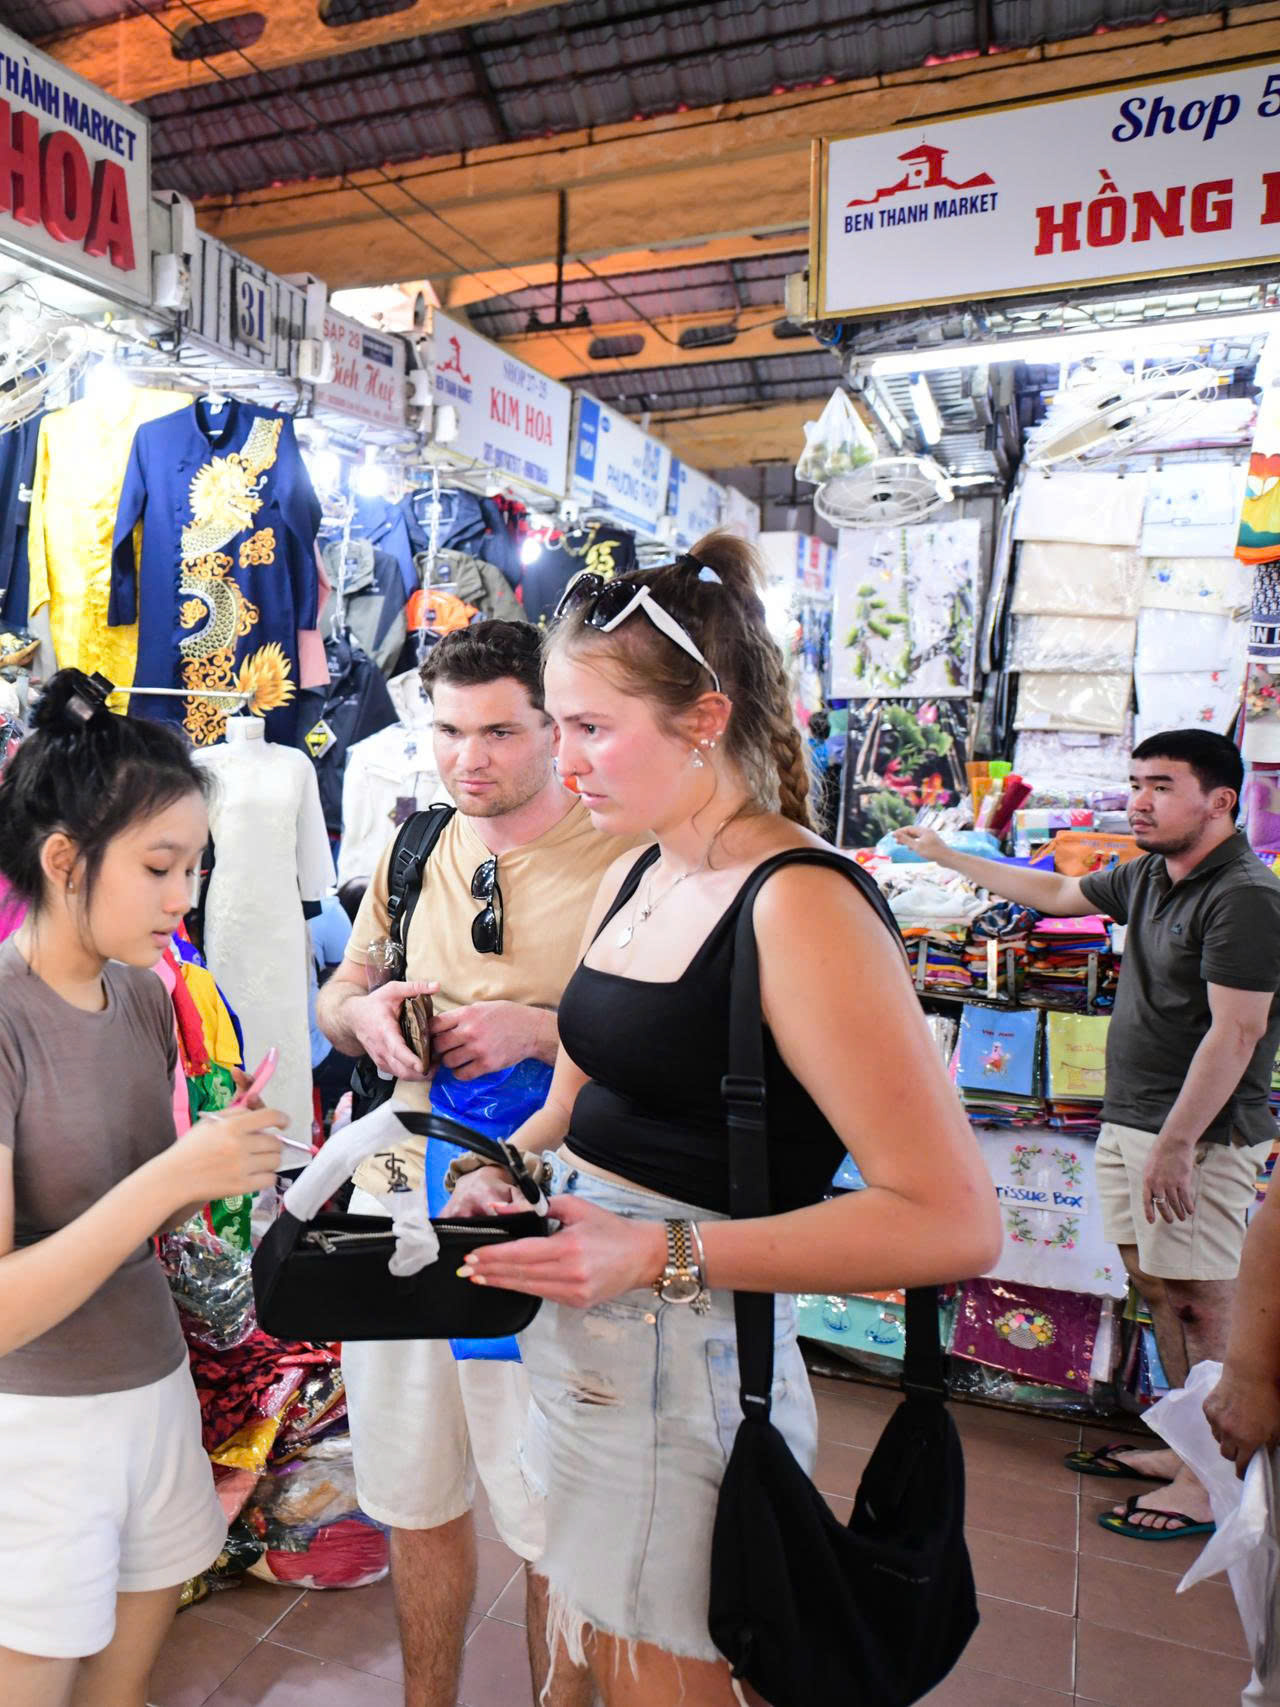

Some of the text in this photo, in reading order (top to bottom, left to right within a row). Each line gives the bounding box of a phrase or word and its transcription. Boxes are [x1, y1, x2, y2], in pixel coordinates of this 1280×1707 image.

[63, 92, 137, 161] MARKET
[1111, 92, 1241, 142] Shop
[844, 192, 998, 234] BEN THANH MARKET
[1034, 169, 1233, 256] HỒNG
[241, 281, 265, 343] 31
[490, 386, 552, 446] KIM HOA
[1053, 1191, 1083, 1208] Box
